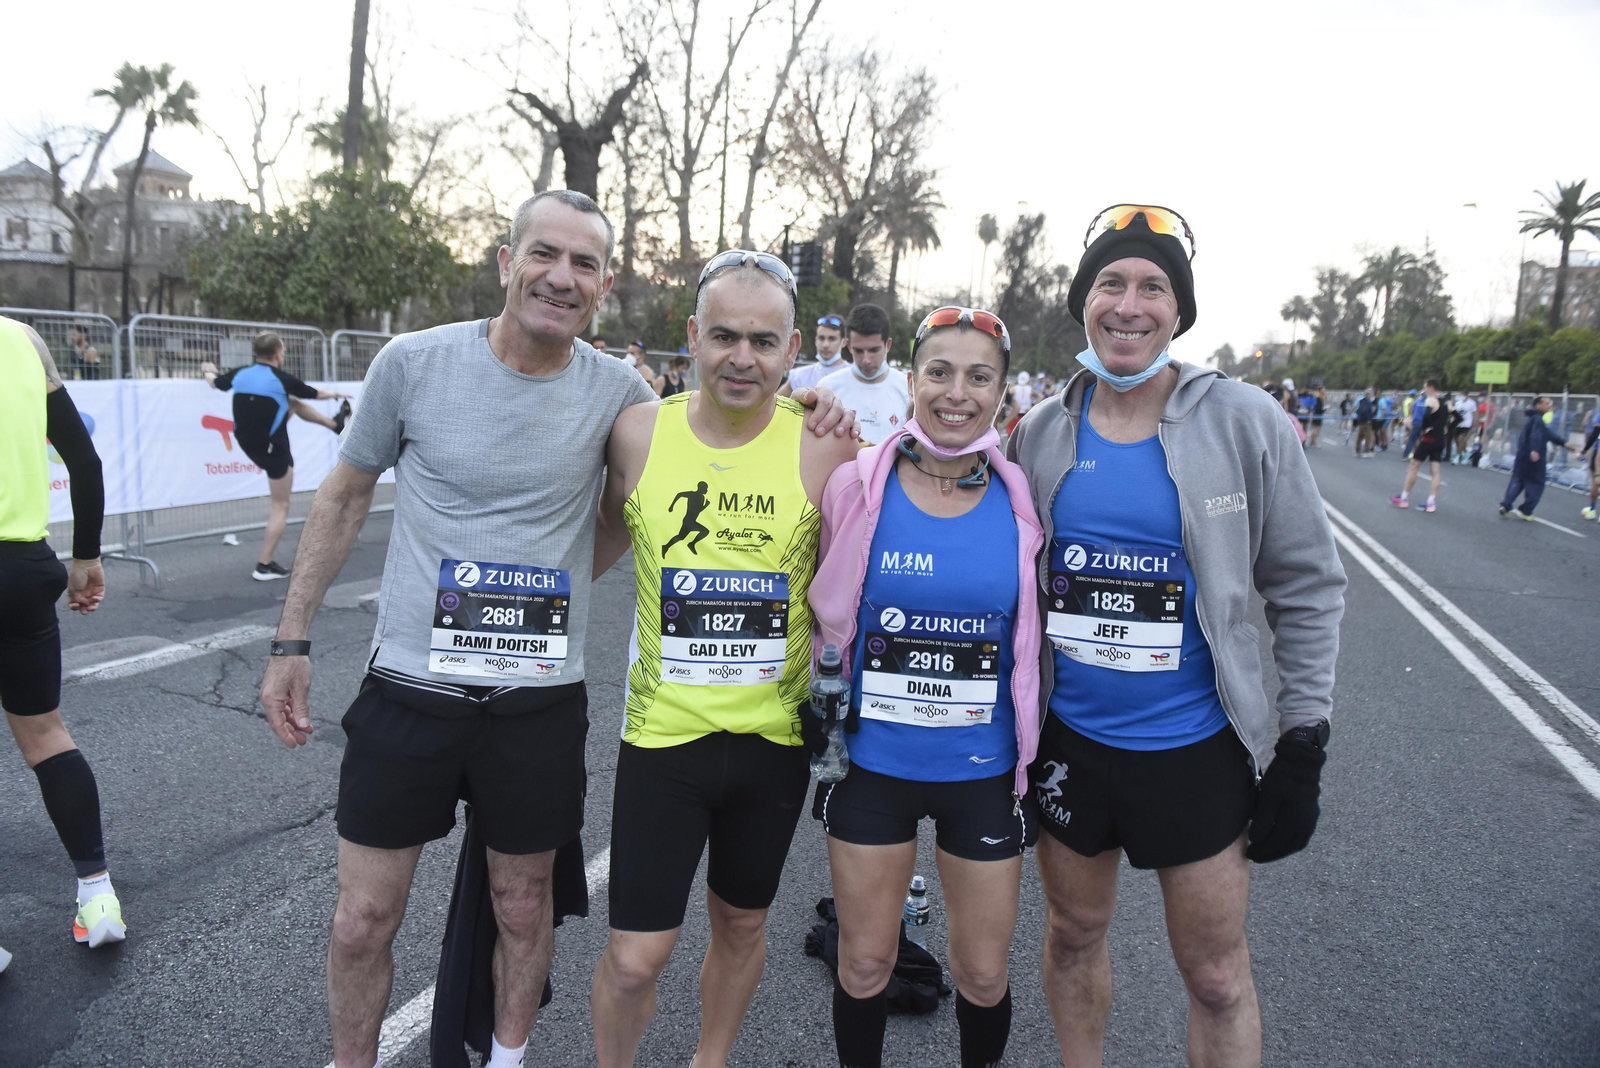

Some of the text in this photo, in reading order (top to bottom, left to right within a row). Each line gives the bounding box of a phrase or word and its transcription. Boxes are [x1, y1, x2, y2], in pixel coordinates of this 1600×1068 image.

[204, 461, 263, 475] TotalEnerg
[716, 528, 753, 541] Ayalot
[1091, 552, 1168, 573] ZURICH
[485, 570, 555, 589] ZURICH
[702, 577, 773, 593] ZURICH
[1091, 591, 1135, 613] 1825
[482, 607, 525, 626] 2681
[702, 613, 746, 632] 1827
[910, 616, 985, 634] ZURICH
[1093, 623, 1128, 639] JEFF
[453, 634, 548, 653] RAMI DOITSH
[689, 644, 757, 657] GAD LEVY
[1063, 645, 1078, 653] asics
[909, 651, 954, 672] 2916
[907, 681, 952, 698] DIANA
